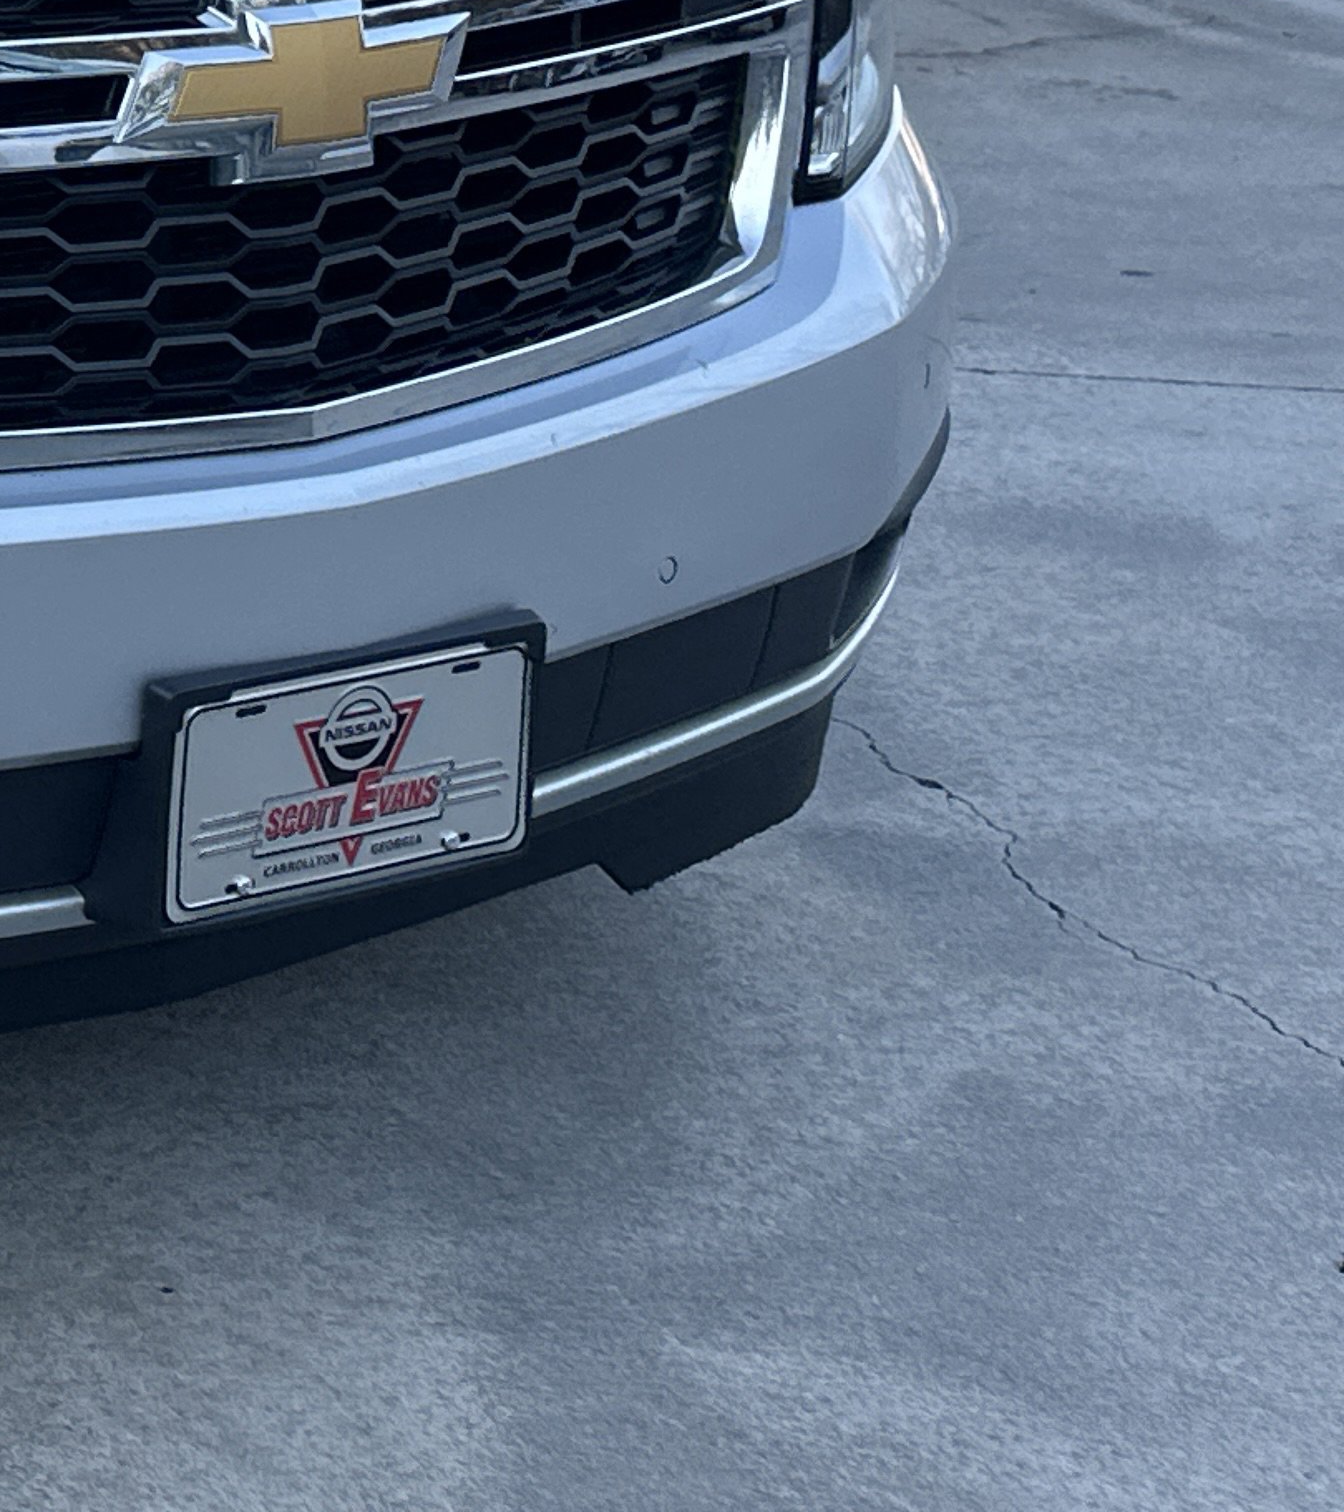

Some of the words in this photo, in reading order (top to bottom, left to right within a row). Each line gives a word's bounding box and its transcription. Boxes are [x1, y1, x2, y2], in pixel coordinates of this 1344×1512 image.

[324, 717, 393, 742] NISSAN
[264, 794, 348, 840] SCOTT
[349, 766, 442, 827] EVANS
[263, 851, 341, 878] CARROLLTON
[370, 834, 424, 856] GEORGIA
